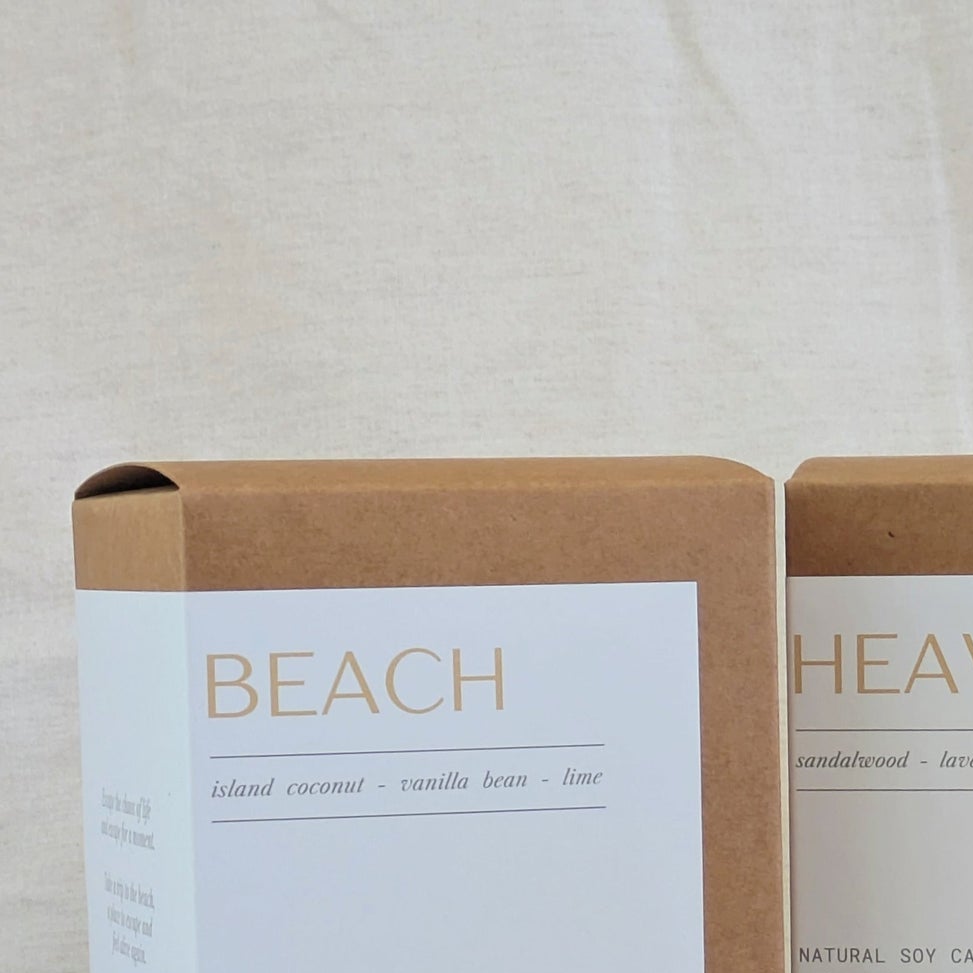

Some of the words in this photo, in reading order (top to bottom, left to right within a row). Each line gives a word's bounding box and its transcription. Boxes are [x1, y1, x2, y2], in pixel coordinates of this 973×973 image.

[206, 647, 504, 718] BEACH
[796, 751, 910, 769] sandalwood
[211, 778, 275, 798] island
[286, 777, 365, 796] coconut
[400, 771, 469, 792] vanilla
[483, 770, 528, 789] bean
[562, 767, 603, 787] lime
[799, 948, 885, 964] NATURAL
[900, 948, 937, 964] SOY
